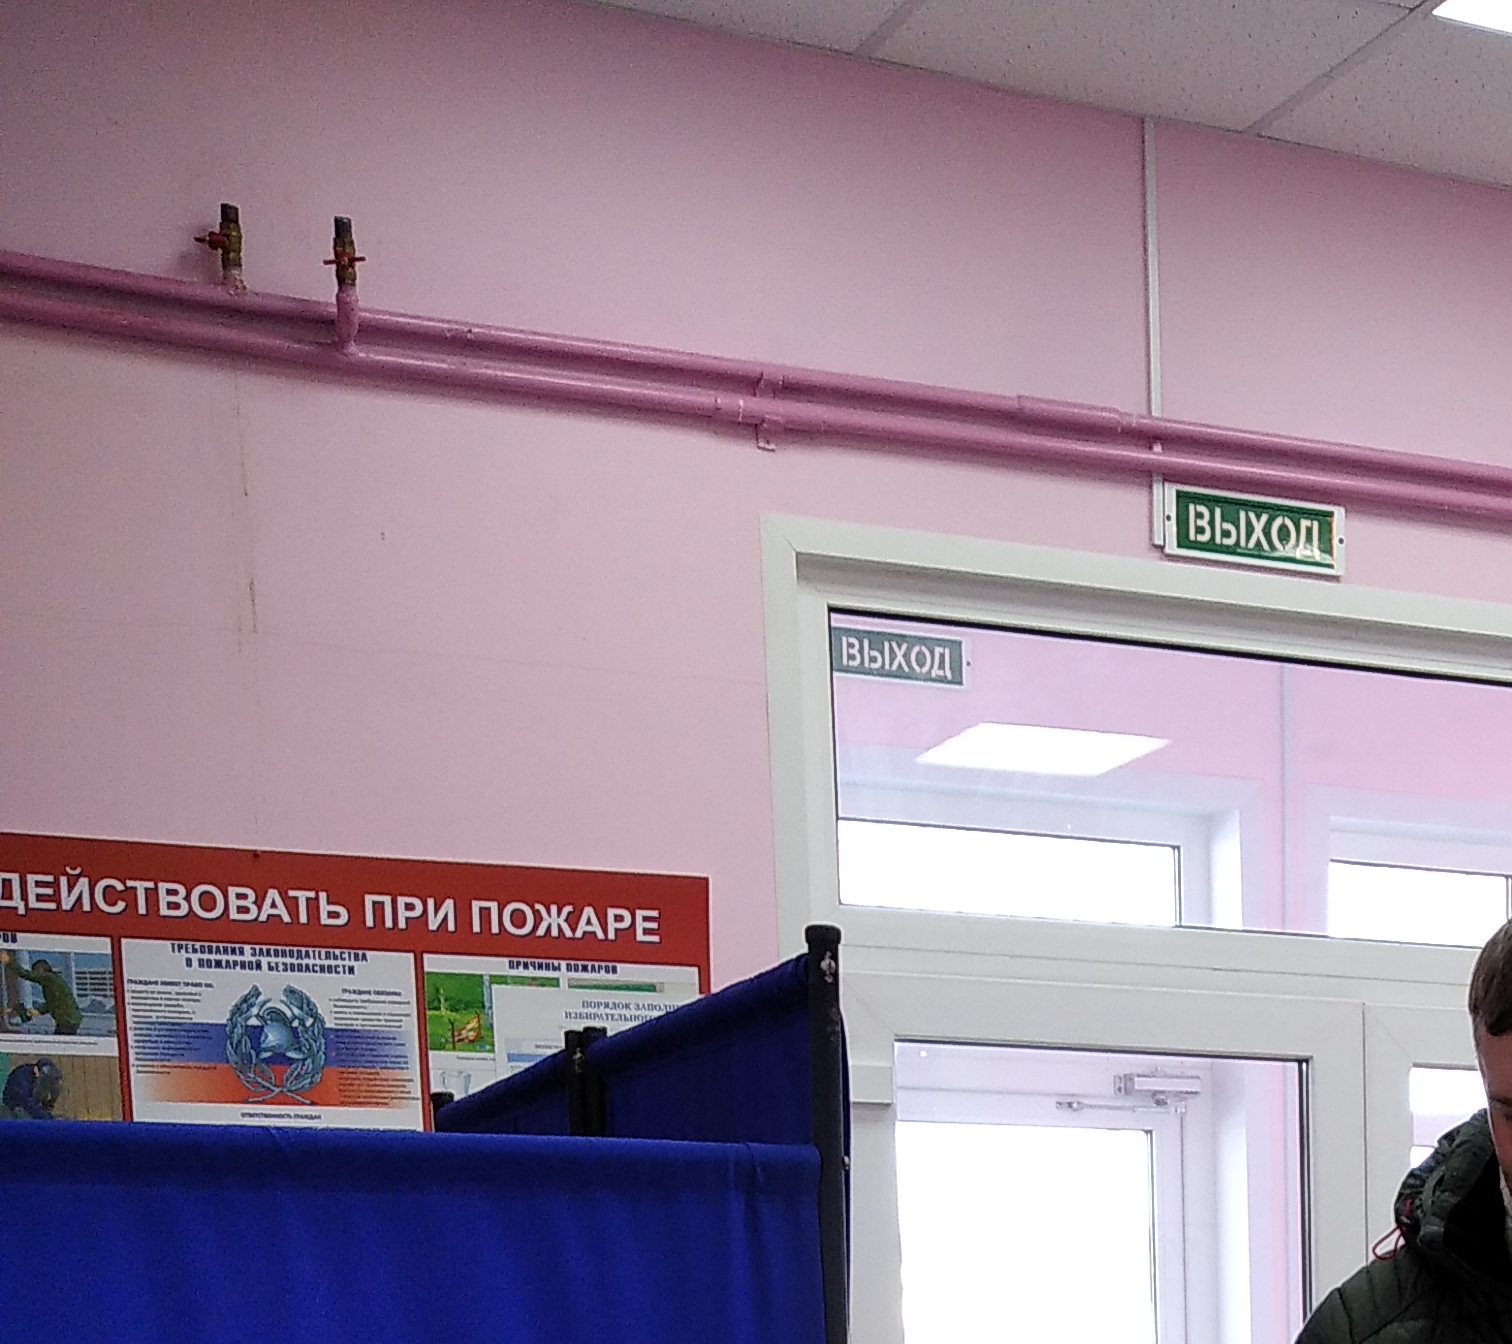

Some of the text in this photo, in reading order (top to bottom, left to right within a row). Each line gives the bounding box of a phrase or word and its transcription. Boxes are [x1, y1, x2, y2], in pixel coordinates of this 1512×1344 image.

[1188, 502, 1321, 560] ВЫХОД
[841, 636, 953, 682] ВЫХОД
[0, 866, 662, 944] ДЕЙСТВОВАТЬ ПРИ ПОЖАРЕ
[170, 942, 369, 963] ТРЕБОВАНИЯ ЗАКОНОДАТЕЛЬСТВА
[197, 957, 263, 972] ПОЖАРНОЙ
[267, 961, 356, 976] БЕЗОПАСНОСТИ
[508, 959, 618, 975] ПРИЧИНЫ ПОЖАРОВ
[581, 1000, 631, 1011] ПОРЯДОК
